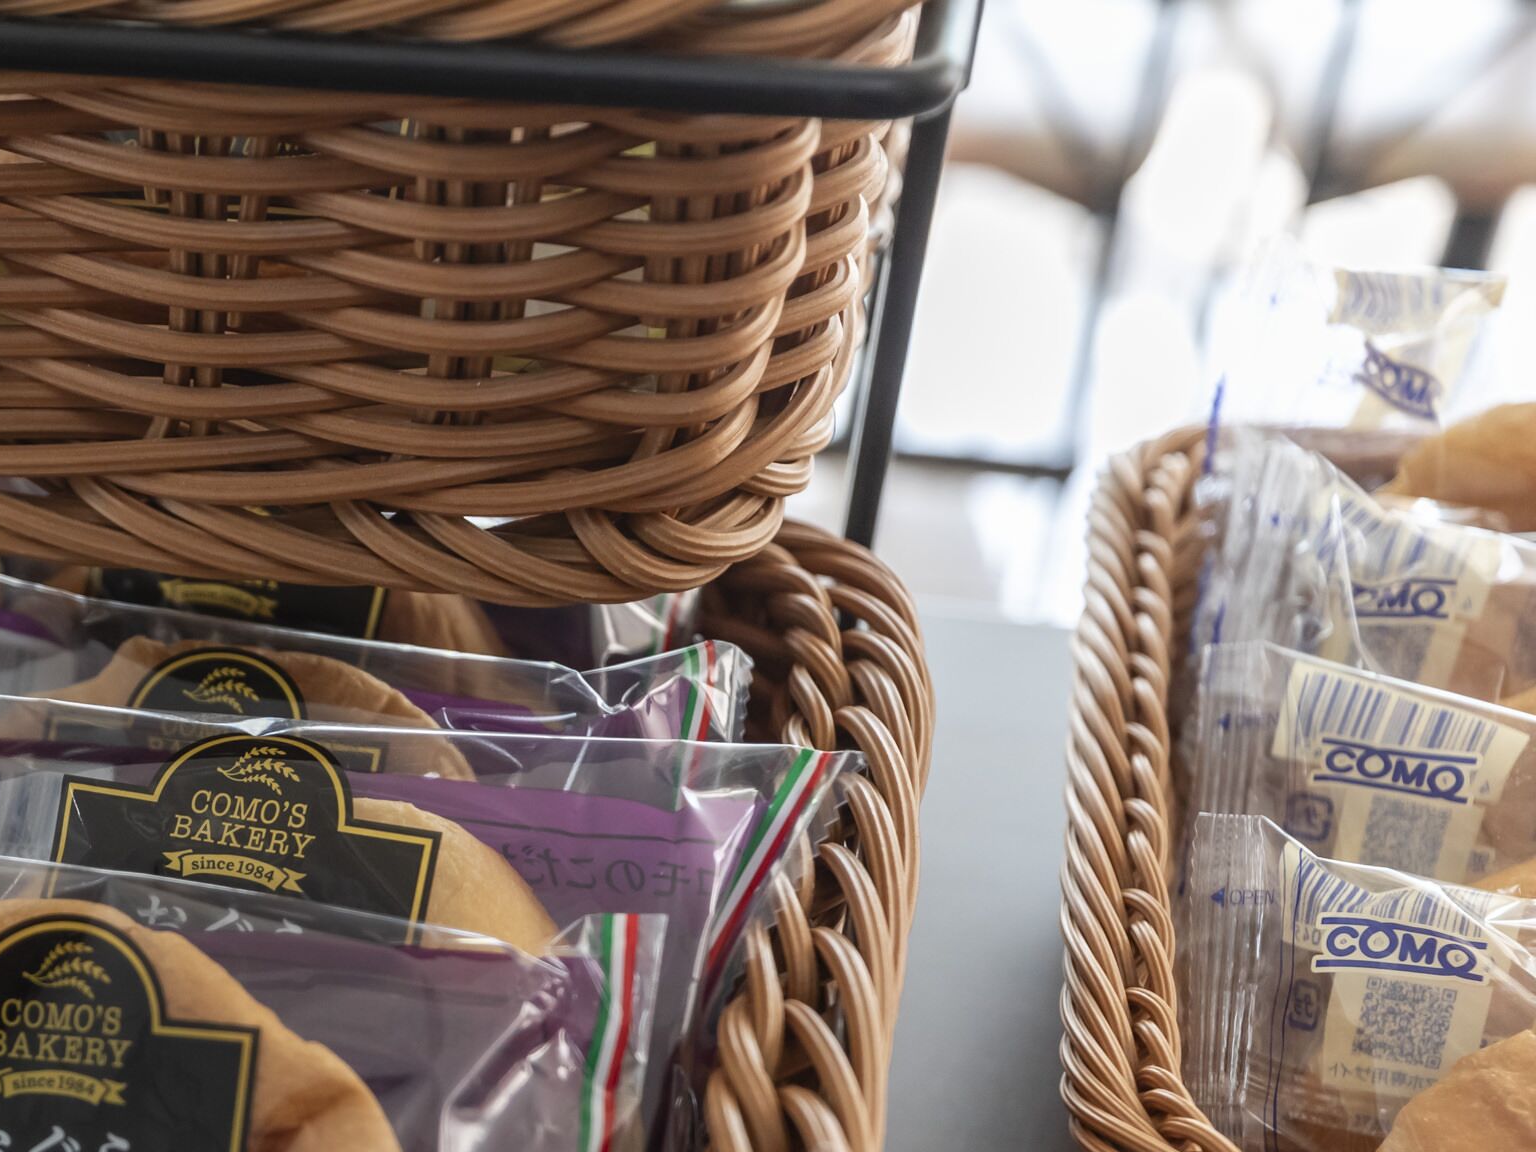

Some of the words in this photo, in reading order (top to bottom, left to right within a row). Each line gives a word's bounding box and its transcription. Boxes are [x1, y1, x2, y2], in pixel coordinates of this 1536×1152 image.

[1317, 739, 1469, 802] COMO
[191, 790, 307, 828] COMO'S
[170, 814, 316, 858] BAKERY
[191, 856, 234, 871] since
[239, 861, 275, 882] 1984
[1318, 919, 1483, 979] COMO
[0, 997, 123, 1036] COMO'S
